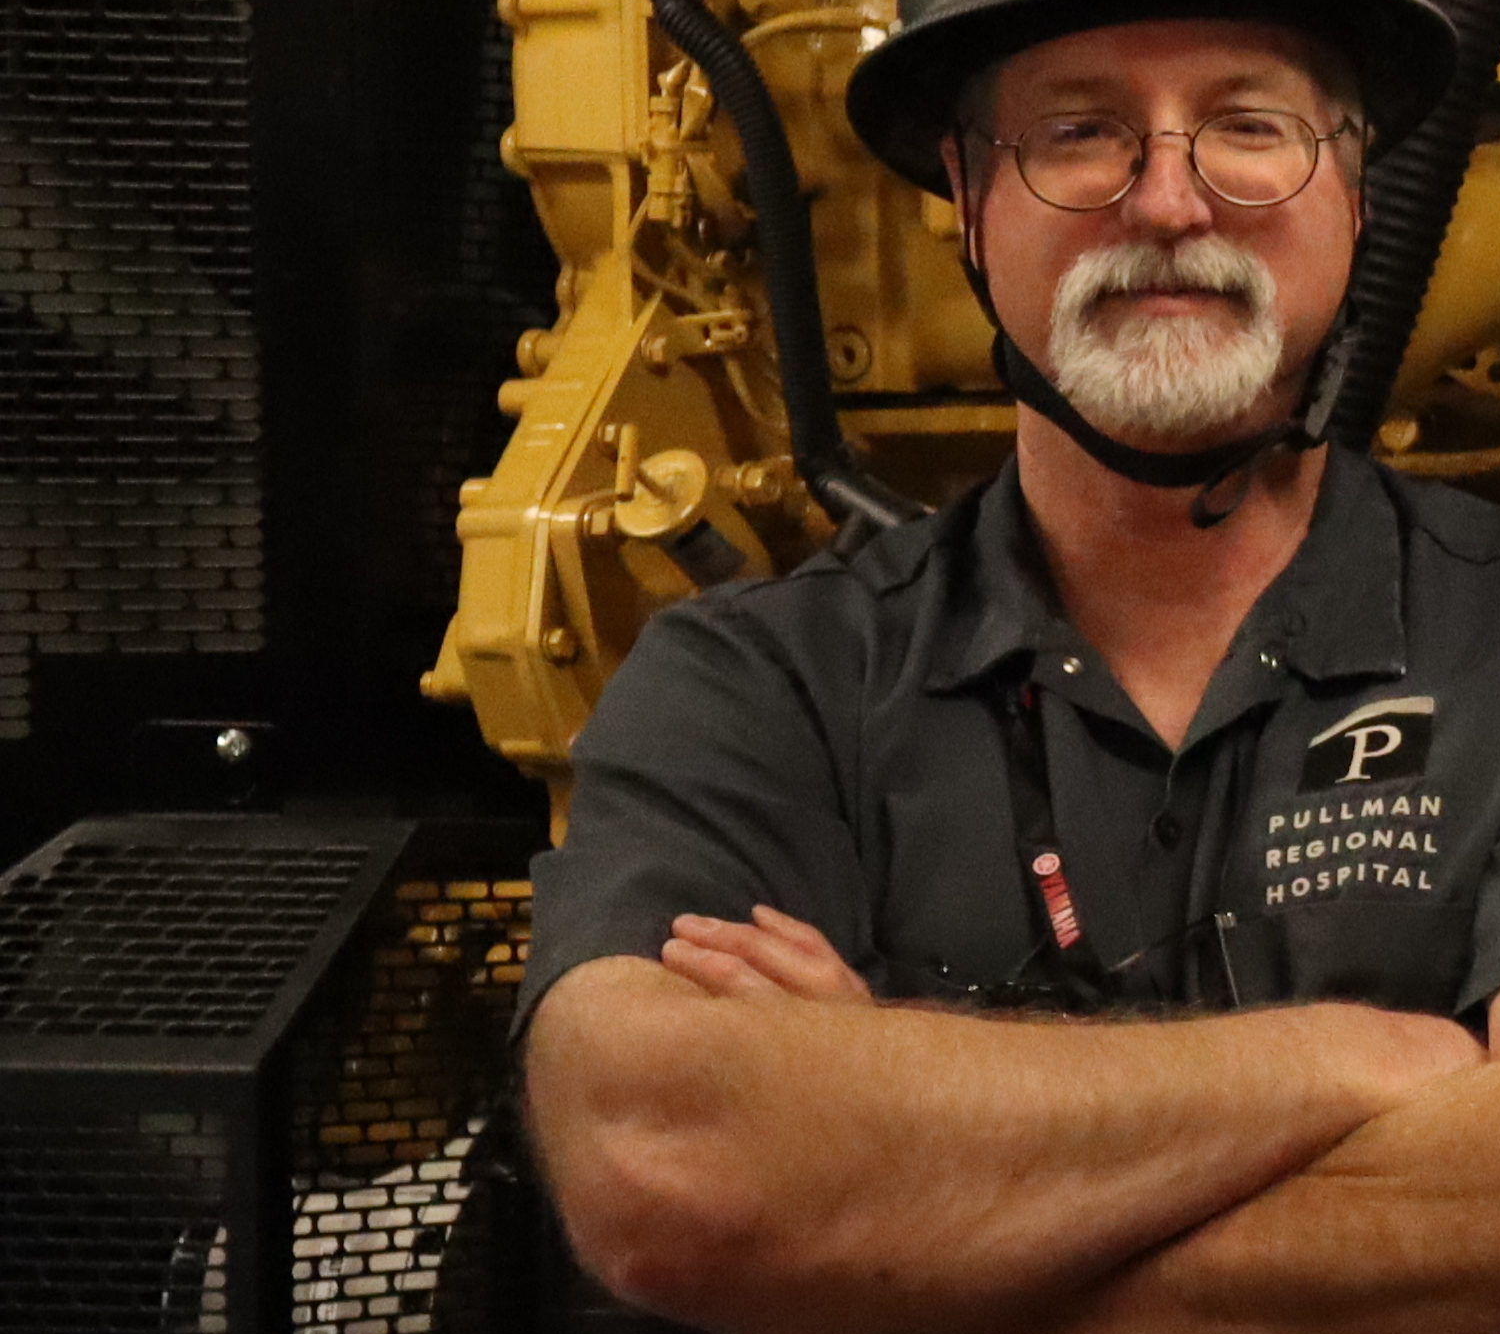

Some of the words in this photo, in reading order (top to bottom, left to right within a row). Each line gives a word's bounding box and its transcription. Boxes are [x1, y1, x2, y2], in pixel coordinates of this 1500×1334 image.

[1335, 724, 1402, 784] P
[1268, 796, 1442, 834] PULLMAN
[1265, 829, 1438, 869] REGIONAL
[1266, 863, 1432, 905] HOSPITAL
